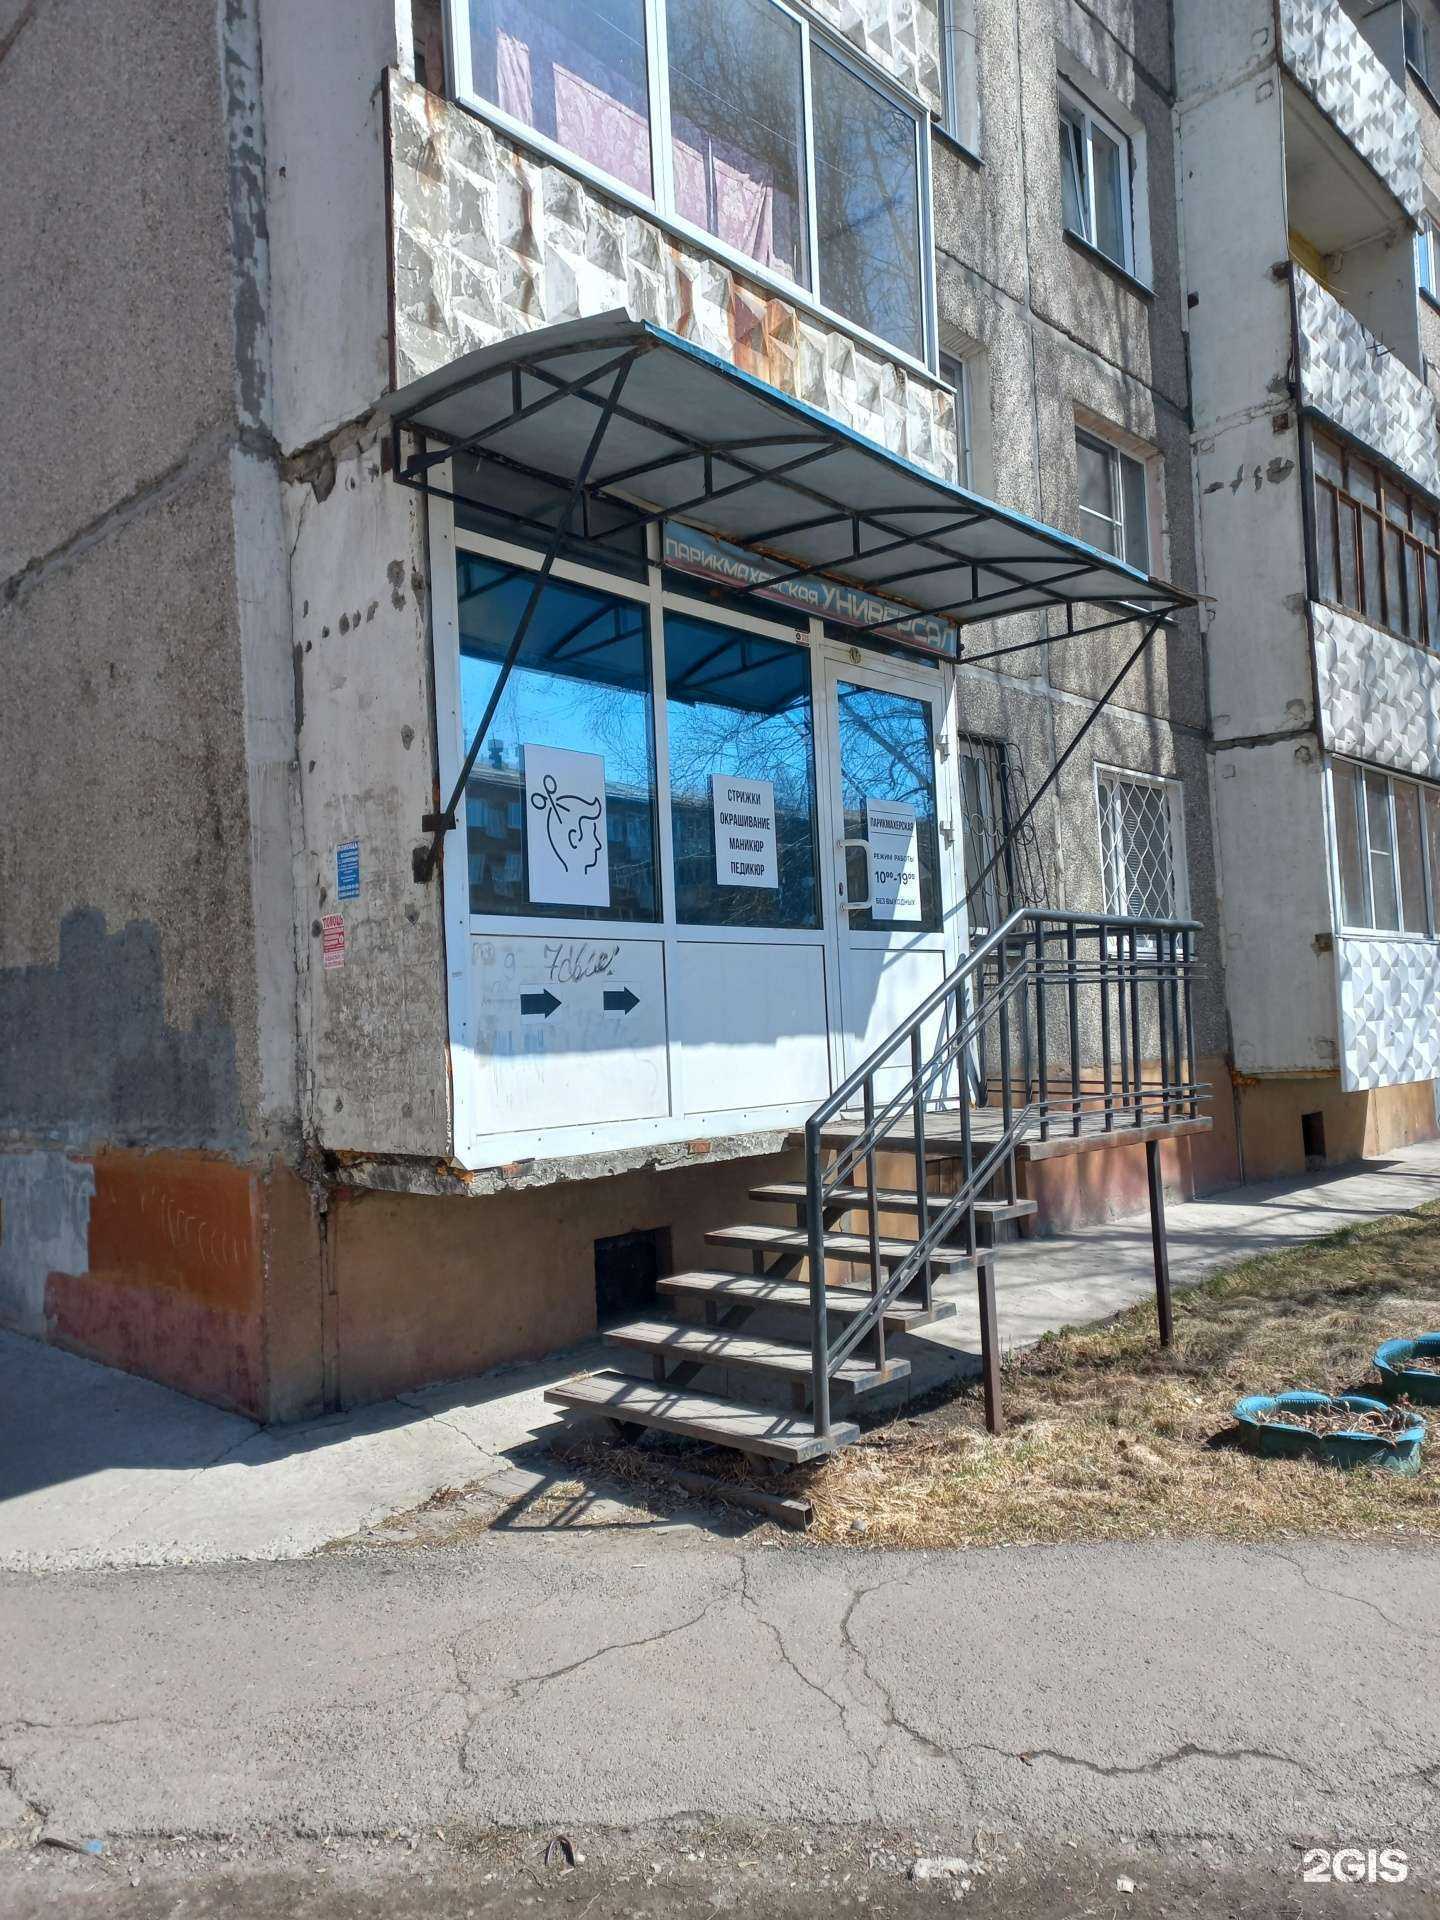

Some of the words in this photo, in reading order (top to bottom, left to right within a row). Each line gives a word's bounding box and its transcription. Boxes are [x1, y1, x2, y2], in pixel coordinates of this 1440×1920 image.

[665, 537, 819, 606] ПАРИКМАХЕСКАЯ
[727, 788, 761, 806] СТРИЖКИ
[719, 811, 771, 831] ОКРАШИВАНИЕ
[870, 816, 914, 832] ПАРИКМАХЕРСКАЯ
[729, 837, 764, 853] МАНИКЮР
[873, 852, 893, 861] РЕЖИМ
[894, 853, 914, 863] РАБОТЫ
[730, 861, 765, 877] ПЕДИКЮР
